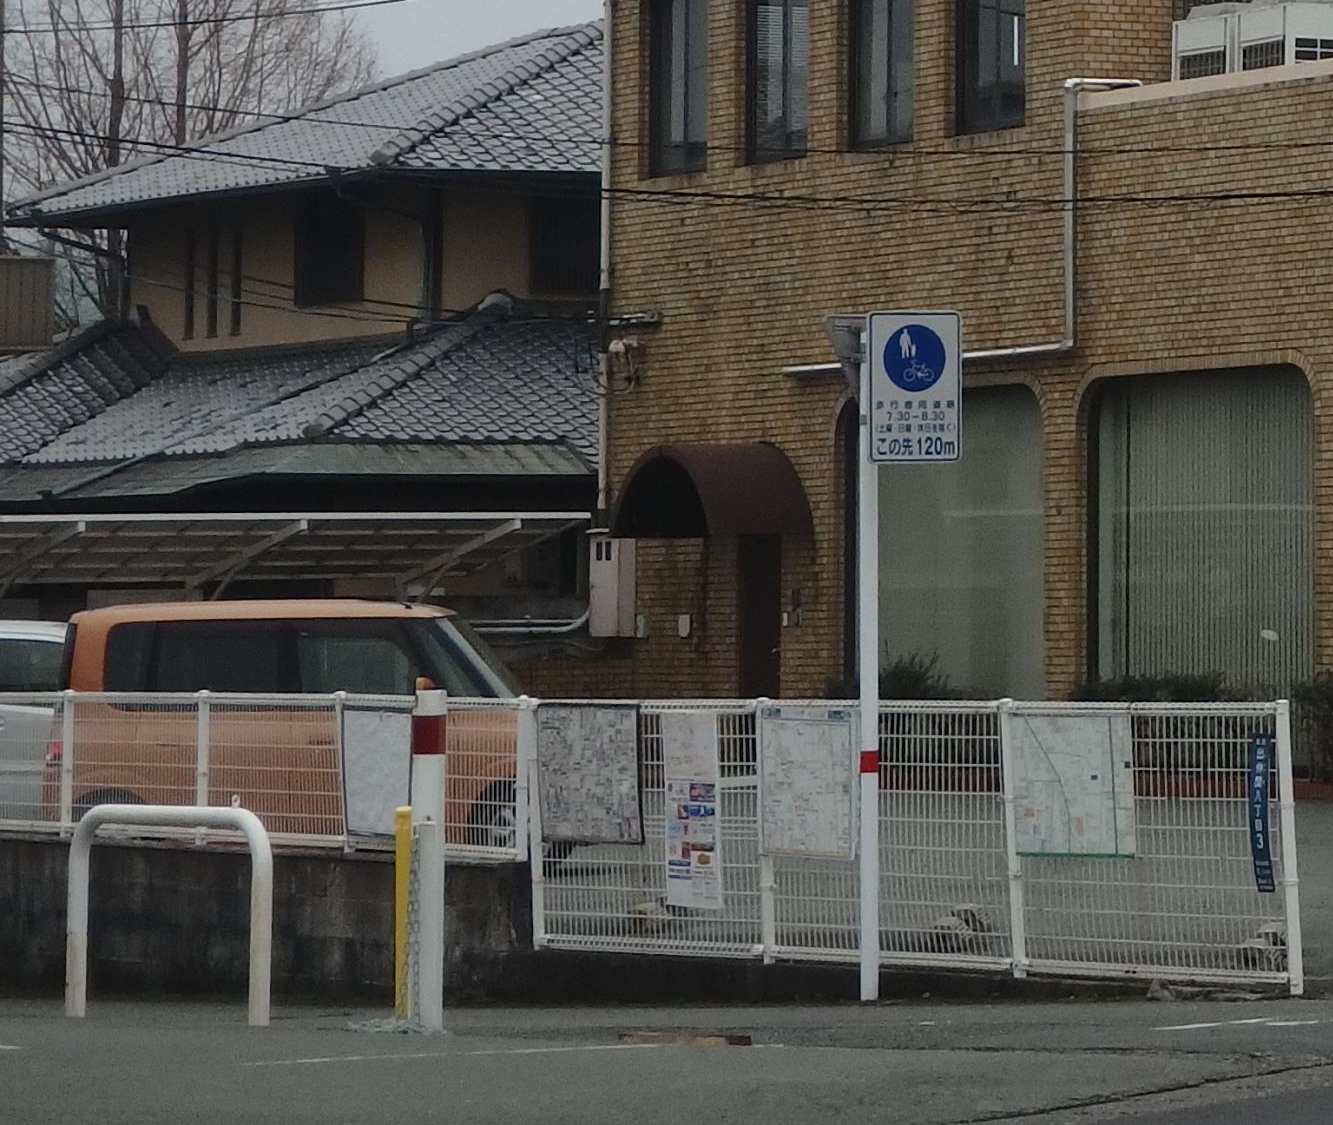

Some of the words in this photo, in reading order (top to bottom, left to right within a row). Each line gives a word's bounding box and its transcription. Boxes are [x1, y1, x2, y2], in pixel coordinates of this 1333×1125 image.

[877, 438, 914, 456] この先
[917, 436, 956, 456] 120m
